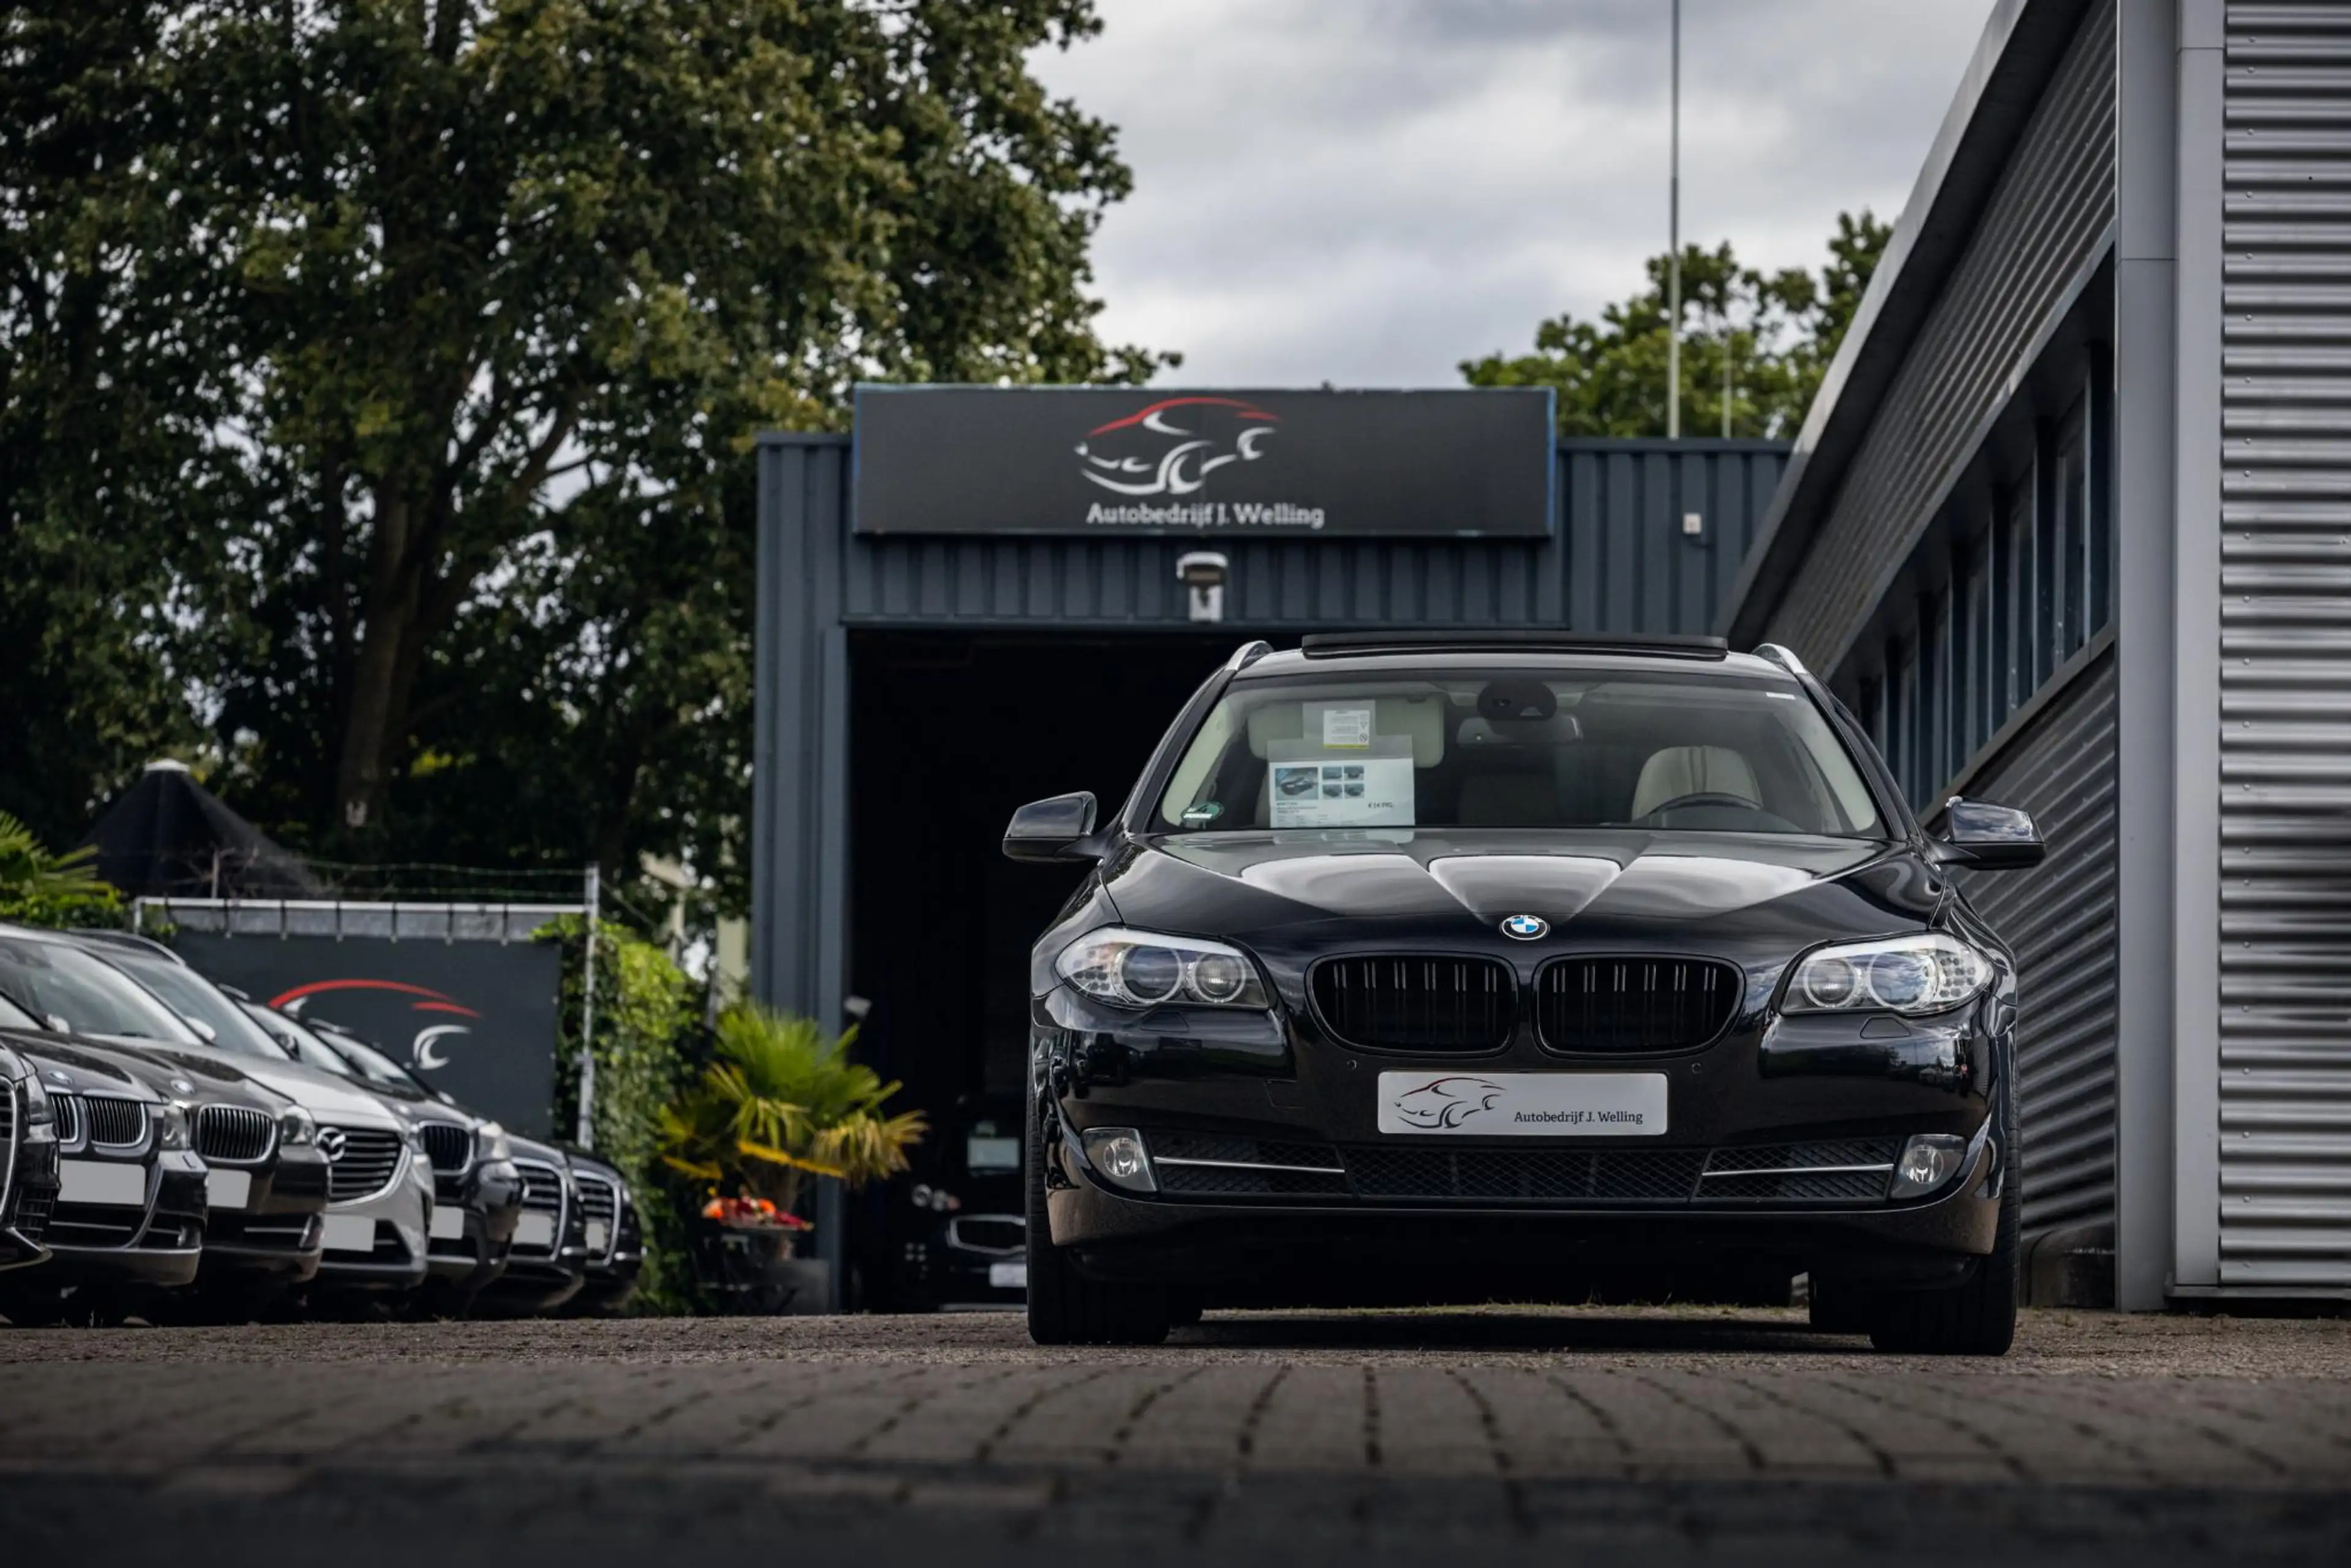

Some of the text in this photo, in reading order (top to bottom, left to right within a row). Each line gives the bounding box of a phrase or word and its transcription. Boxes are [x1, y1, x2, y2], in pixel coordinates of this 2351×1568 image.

[1086, 503, 1325, 529] Autobedrijf J. Welling
[1514, 1111, 1643, 1125] Autobedrijf J. Welling
